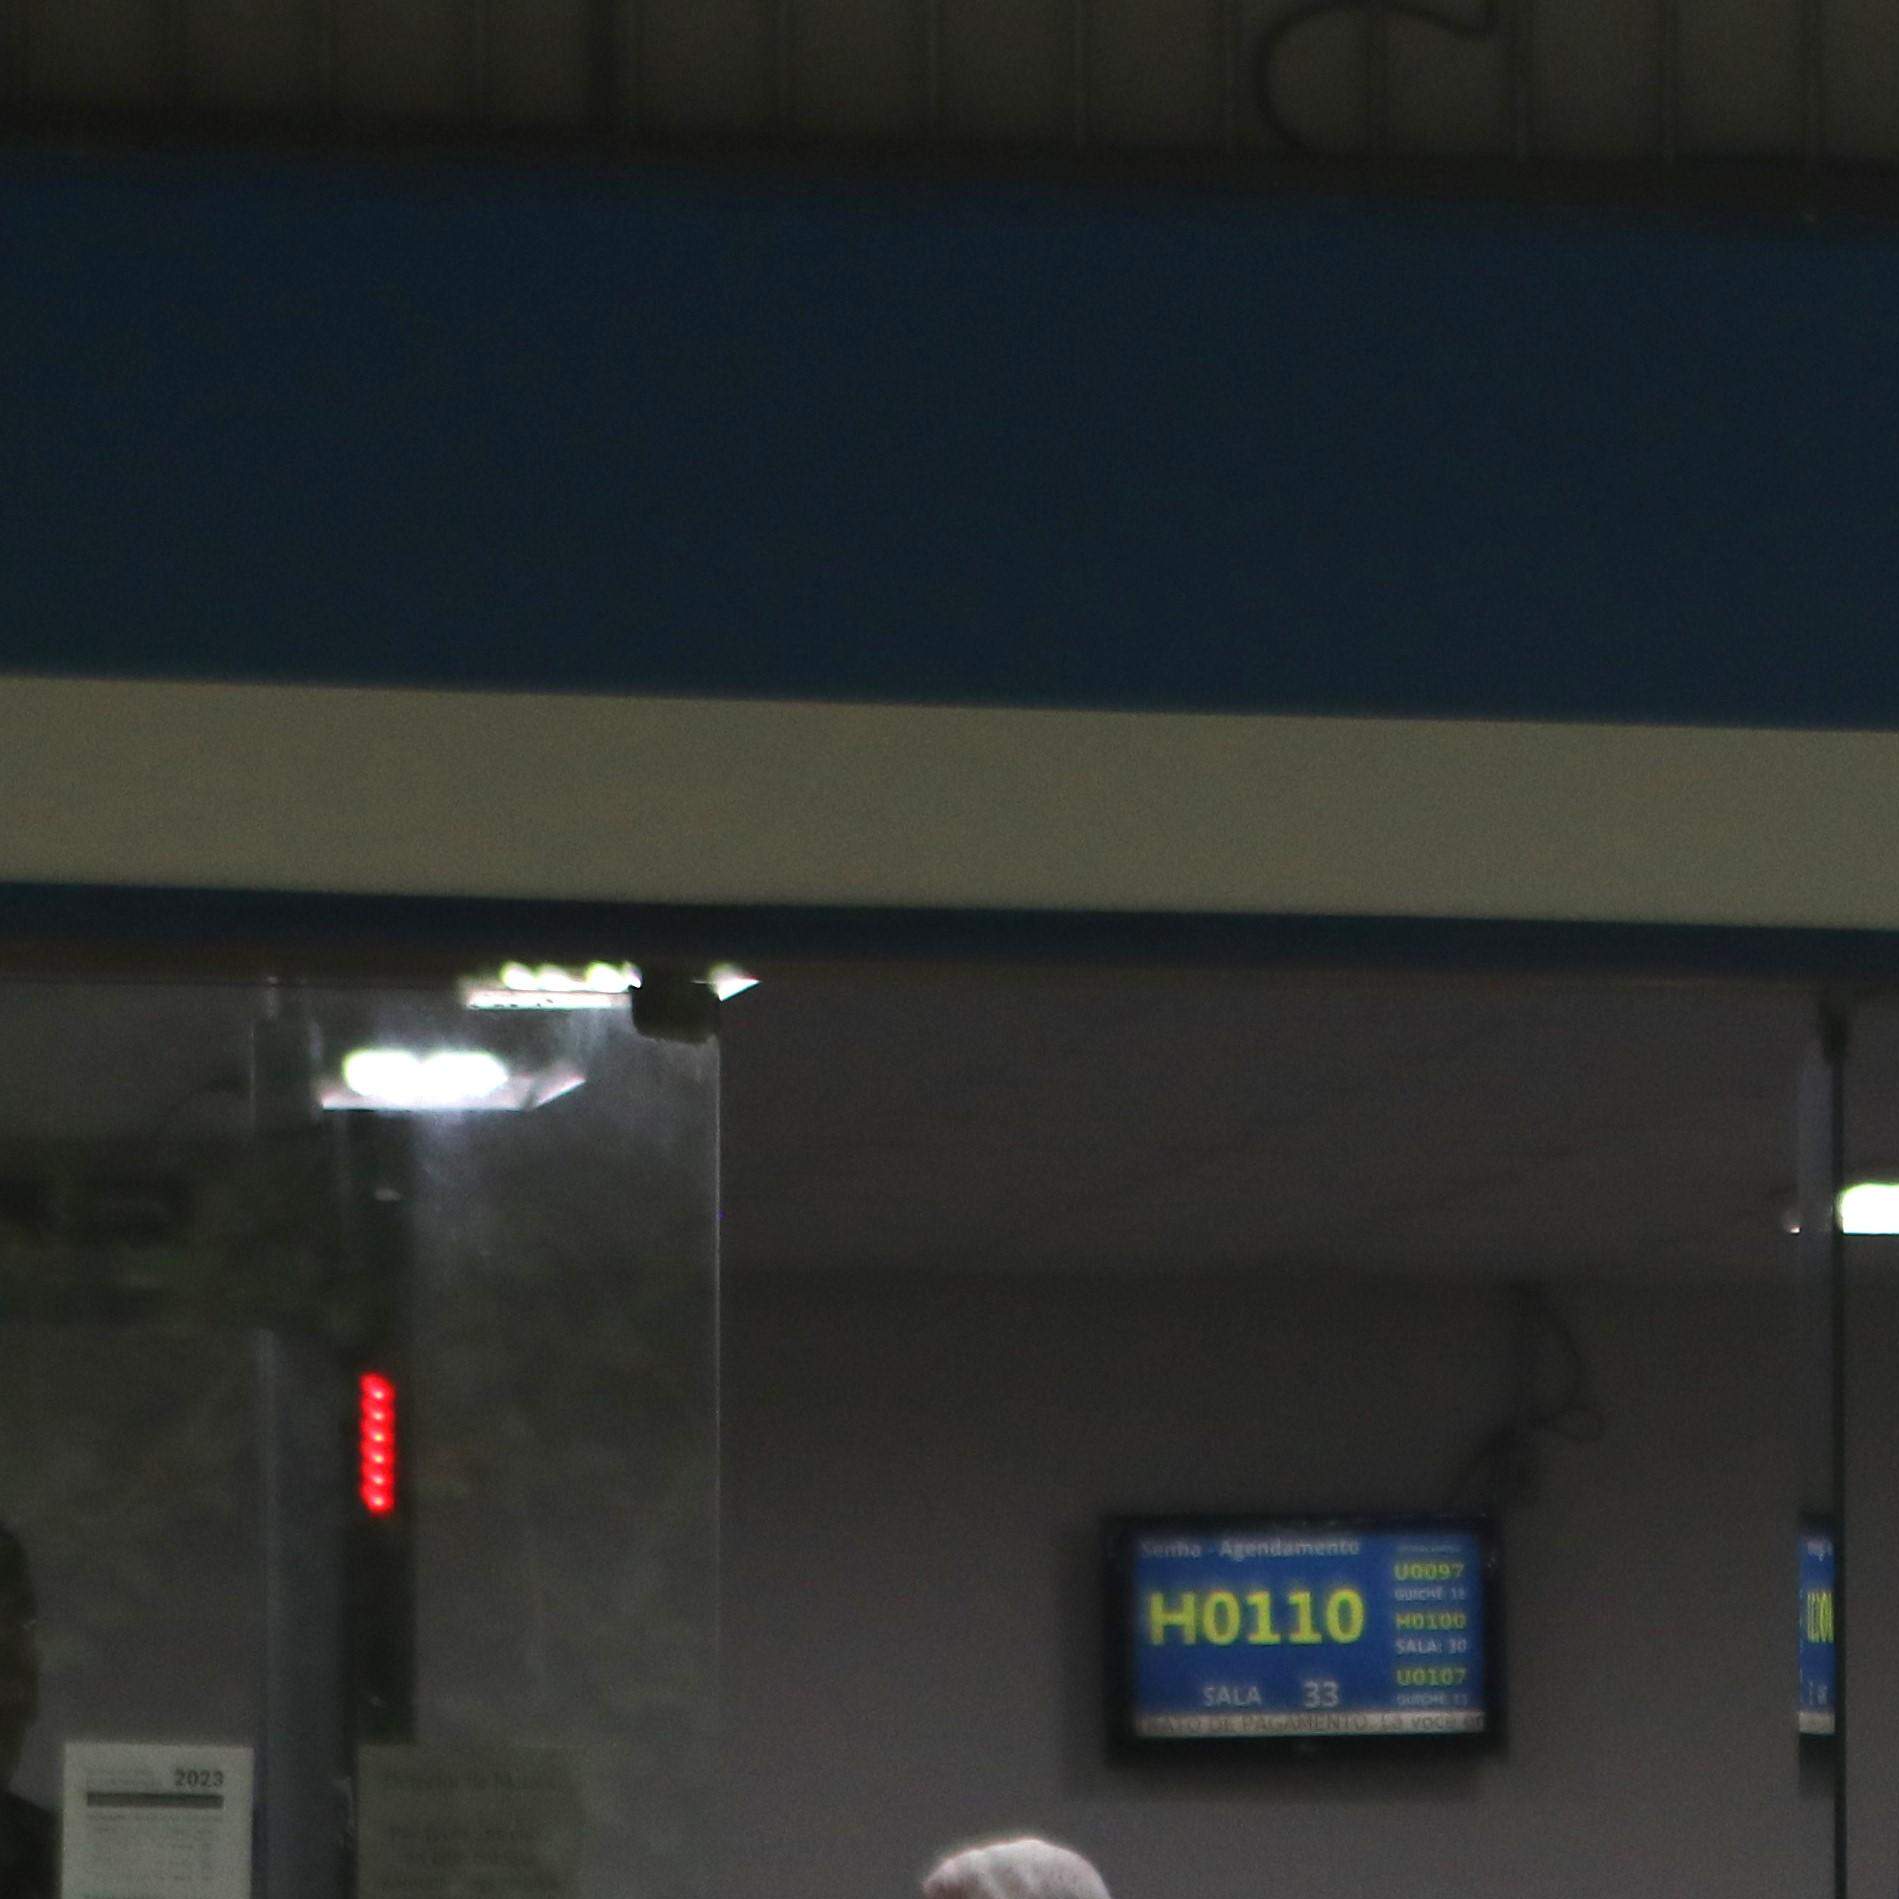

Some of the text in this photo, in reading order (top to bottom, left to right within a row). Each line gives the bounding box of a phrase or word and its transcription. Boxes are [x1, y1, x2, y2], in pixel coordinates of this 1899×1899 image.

[1219, 1538, 1361, 1561] Agendamento
[1148, 1588, 1366, 1646] H0110
[1202, 1680, 1339, 1708] SALA 33
[173, 1768, 224, 1788] 2023
